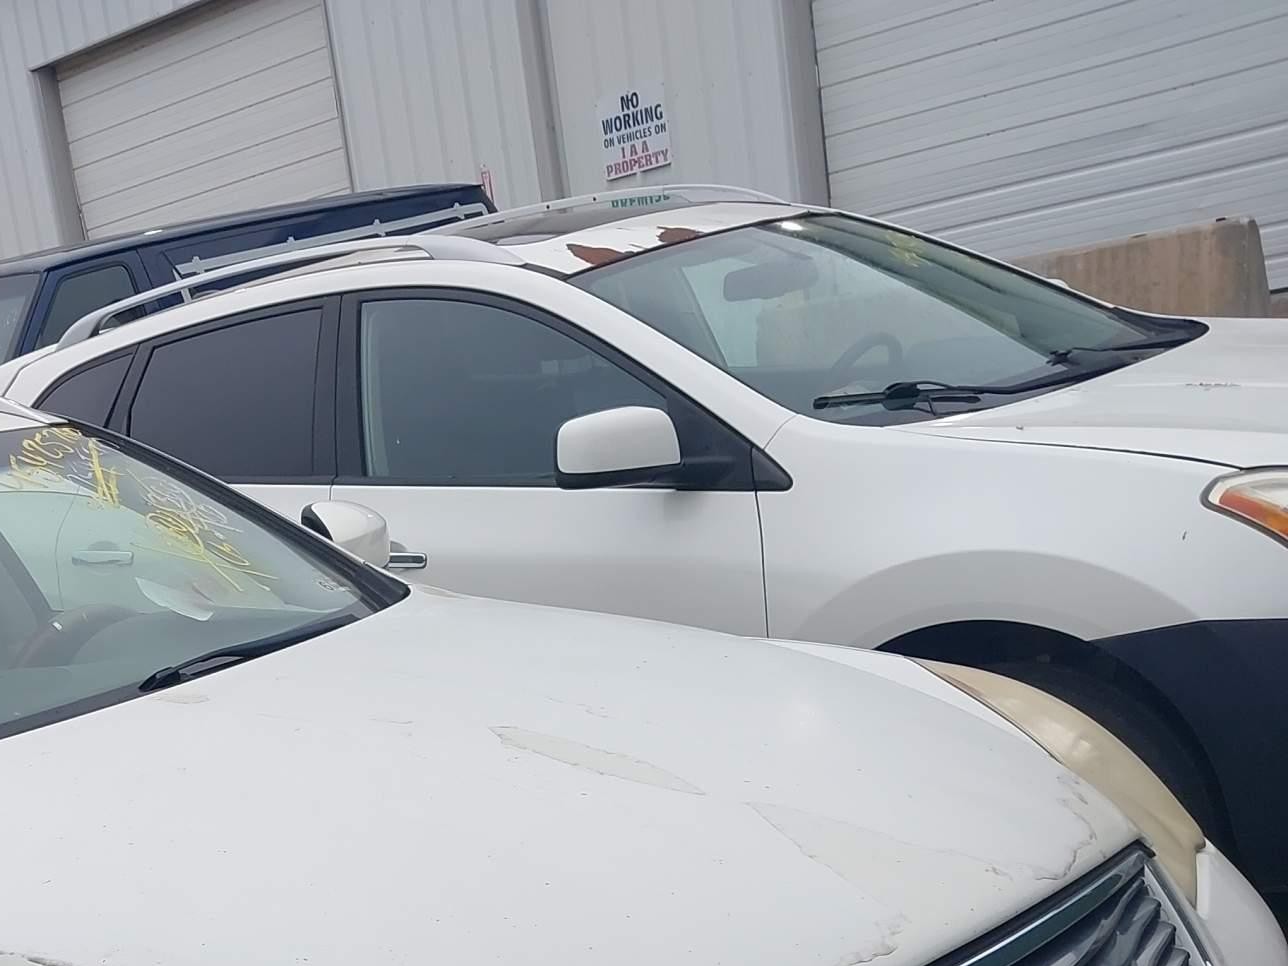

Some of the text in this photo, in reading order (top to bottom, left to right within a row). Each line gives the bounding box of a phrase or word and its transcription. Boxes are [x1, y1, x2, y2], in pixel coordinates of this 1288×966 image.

[620, 92, 639, 112] NO
[602, 104, 663, 136] WORKING
[604, 122, 667, 149] ON VEHICLES ON
[606, 148, 669, 178] PROPERTY
